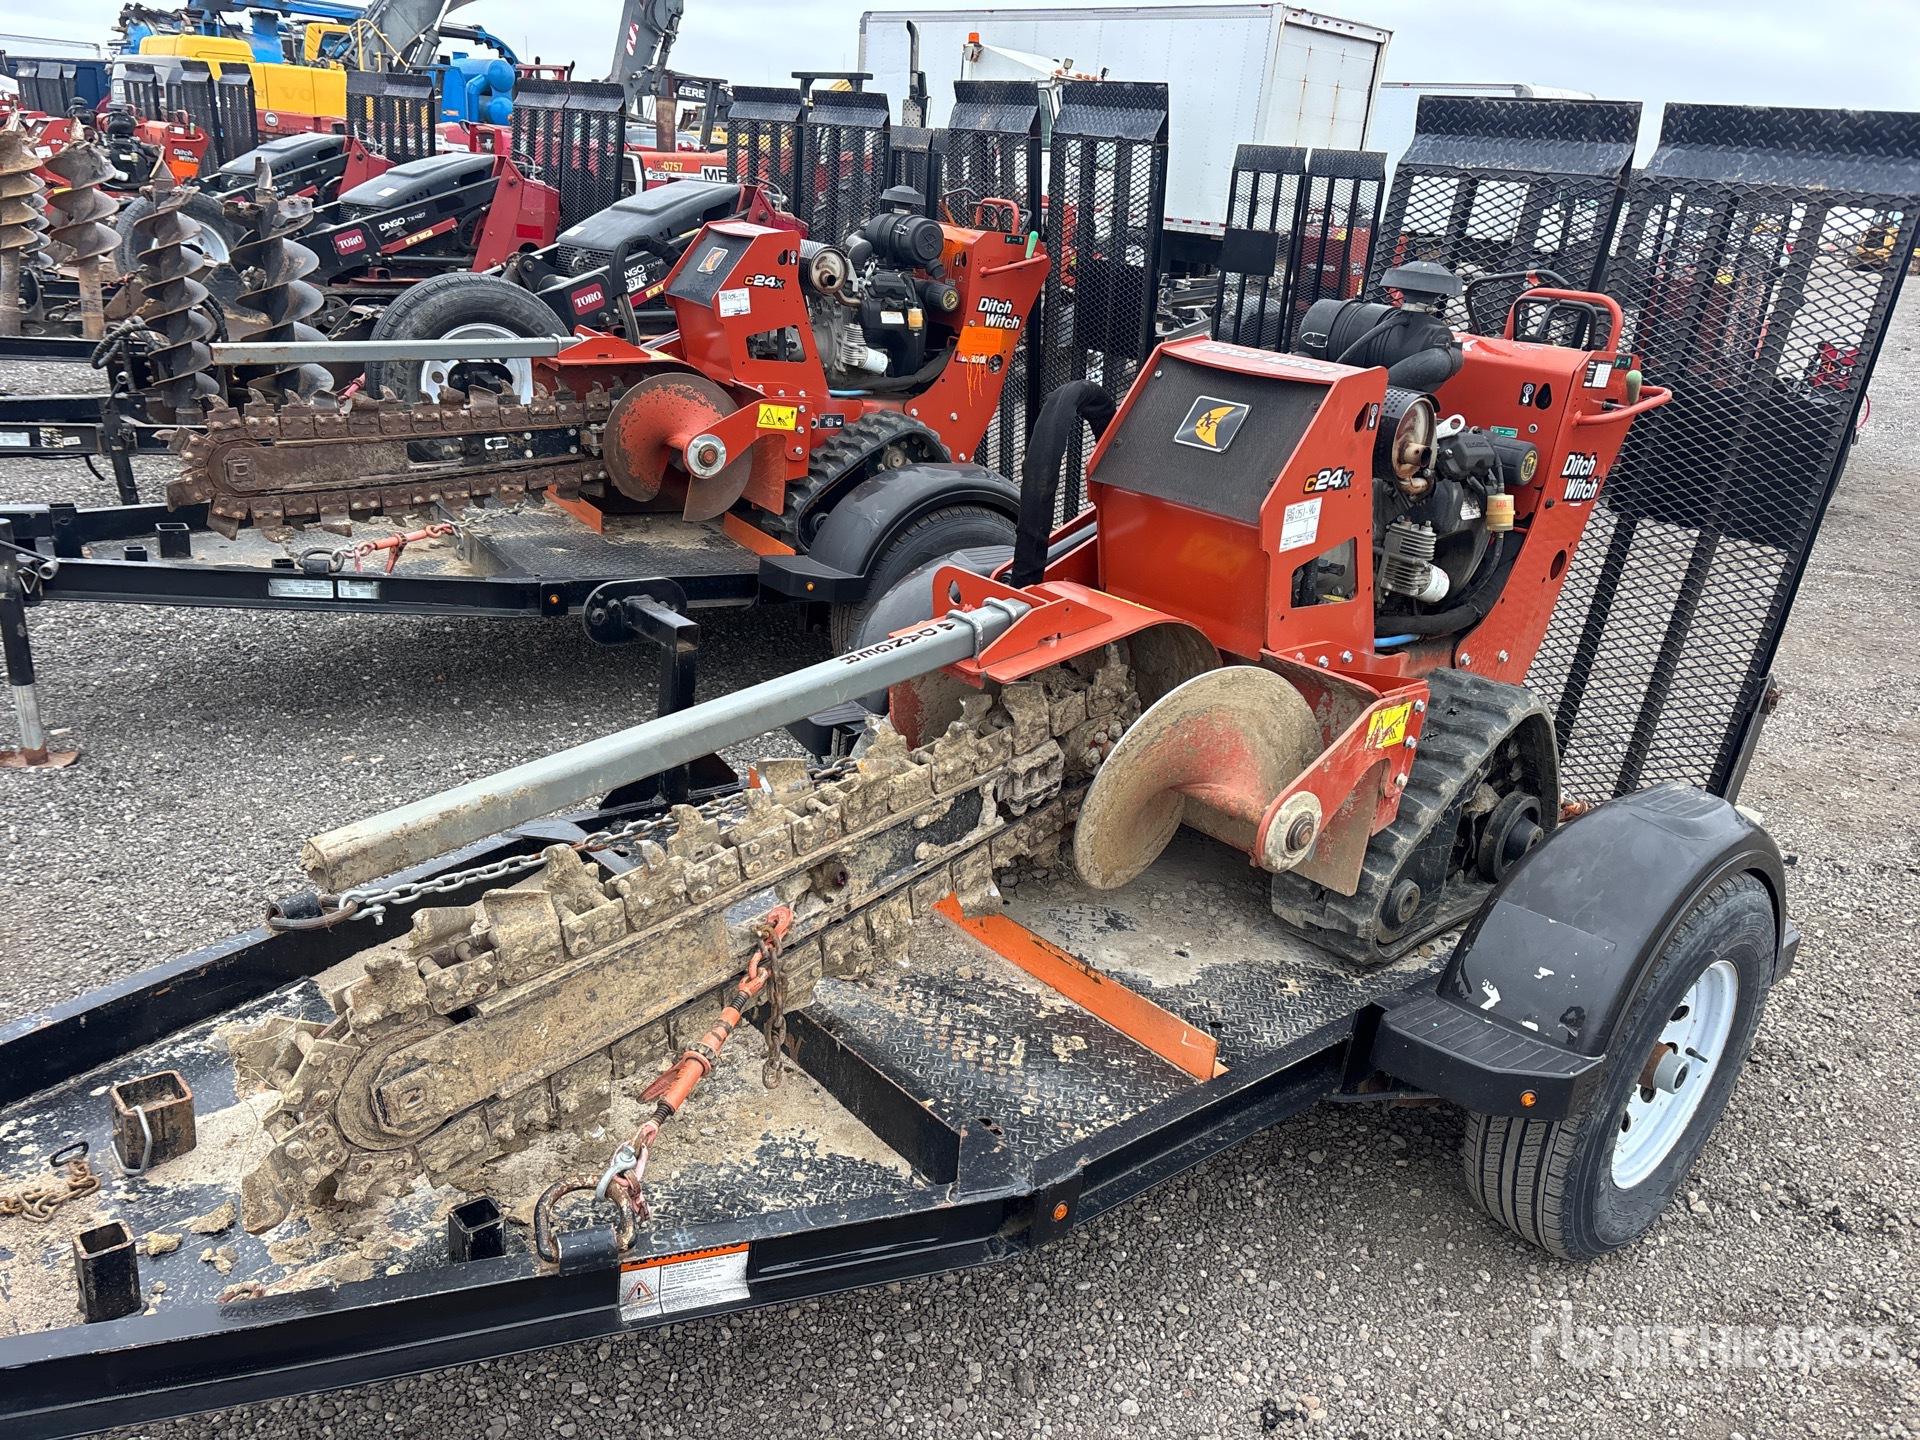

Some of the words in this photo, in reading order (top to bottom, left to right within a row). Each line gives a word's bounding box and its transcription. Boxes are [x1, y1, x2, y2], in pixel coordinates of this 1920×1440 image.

[678, 86, 706, 98] EERE
[173, 148, 193, 156] Ditch
[378, 217, 406, 232] DINGO
[337, 234, 363, 249] TORO
[623, 263, 645, 279] NGO
[574, 290, 603, 308] TORO
[977, 297, 1013, 313] Ditch
[984, 313, 1021, 329] Witch
[1195, 345, 1263, 360] Ditch
[1263, 355, 1339, 374] Witch
[1562, 454, 1597, 476] Ditch
[1564, 478, 1600, 500] Witch
[838, 627, 939, 665] DANGER
